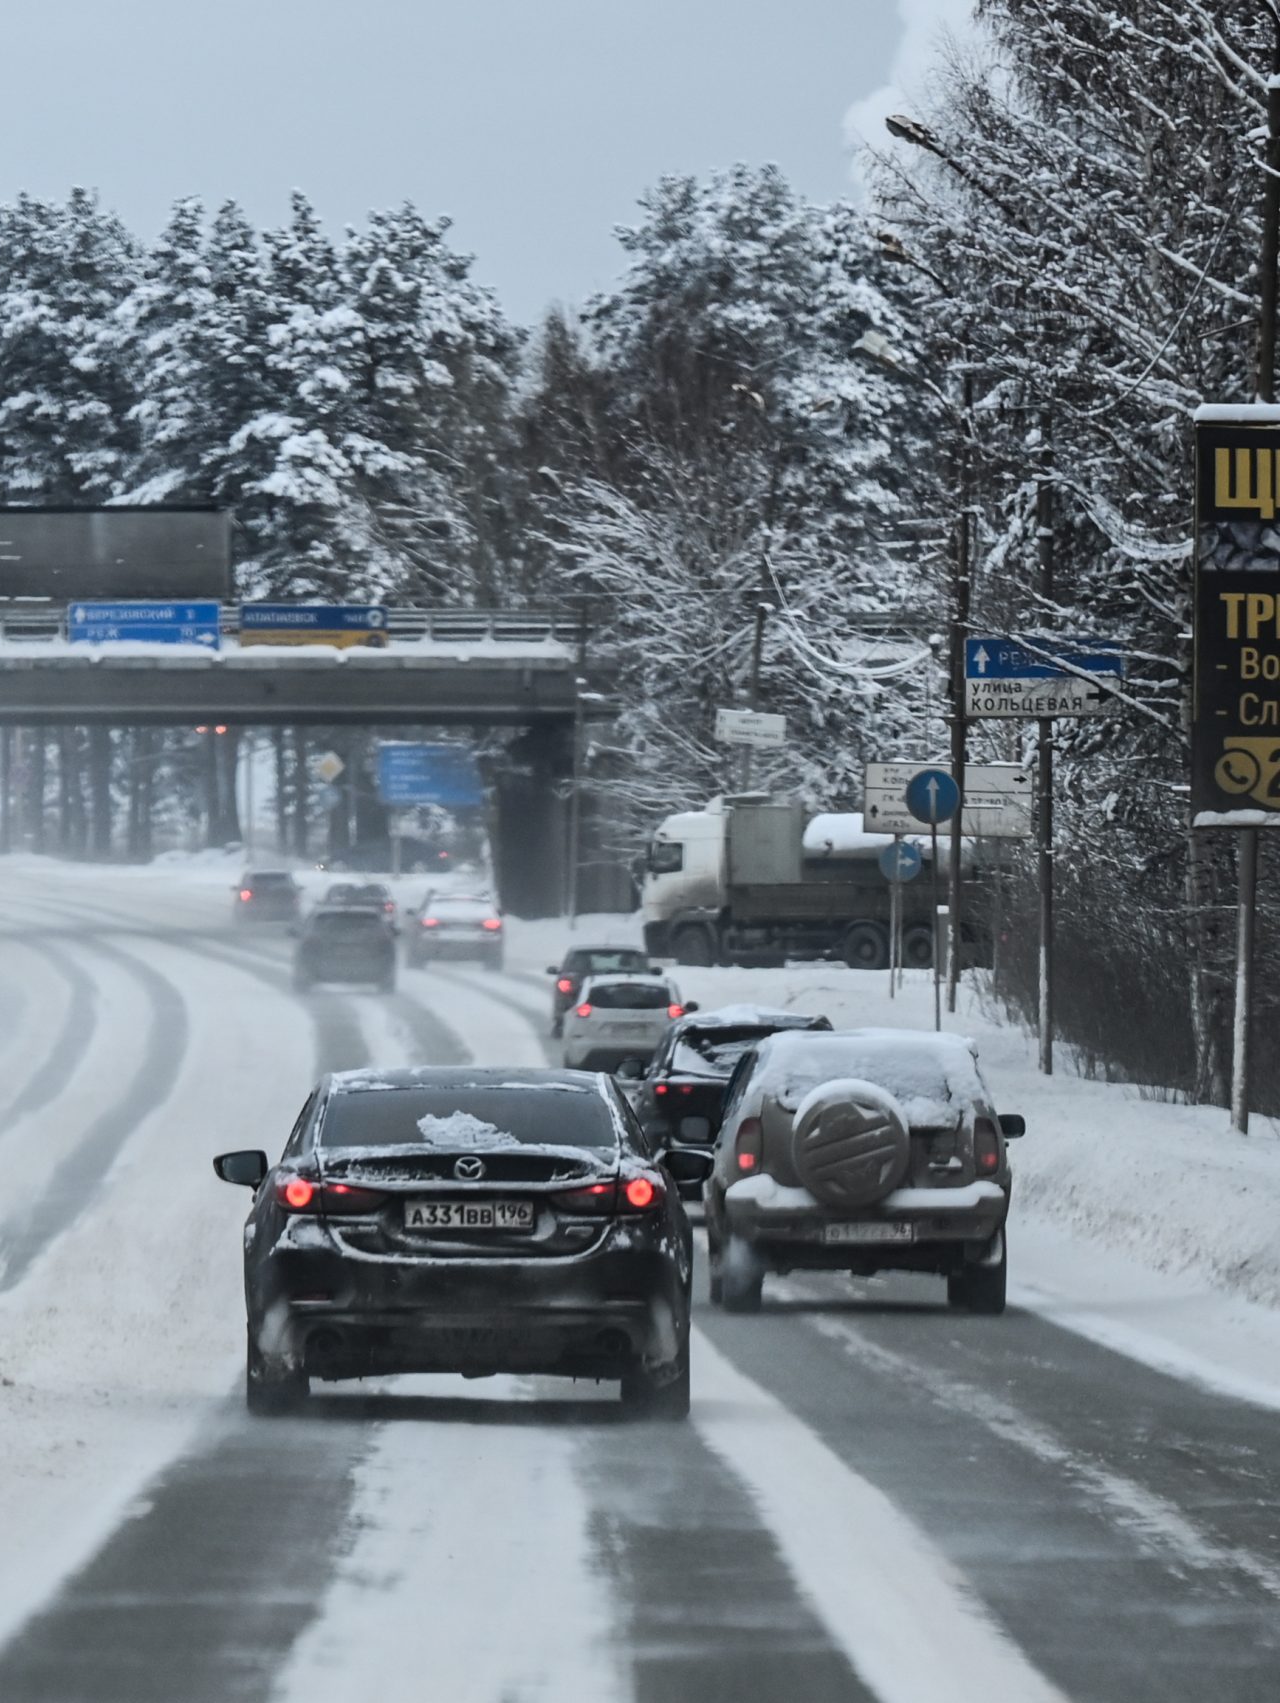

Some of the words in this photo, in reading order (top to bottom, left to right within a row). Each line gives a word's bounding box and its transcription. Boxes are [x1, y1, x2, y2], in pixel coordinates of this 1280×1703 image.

[1215, 448, 1280, 519] Щ
[1220, 593, 1280, 639] ТР
[971, 681, 1023, 696] улица
[971, 697, 1083, 713] КОЛЬЦЕВАЯ
[412, 1204, 493, 1225] А331ВВ
[498, 1203, 528, 1219] 196
